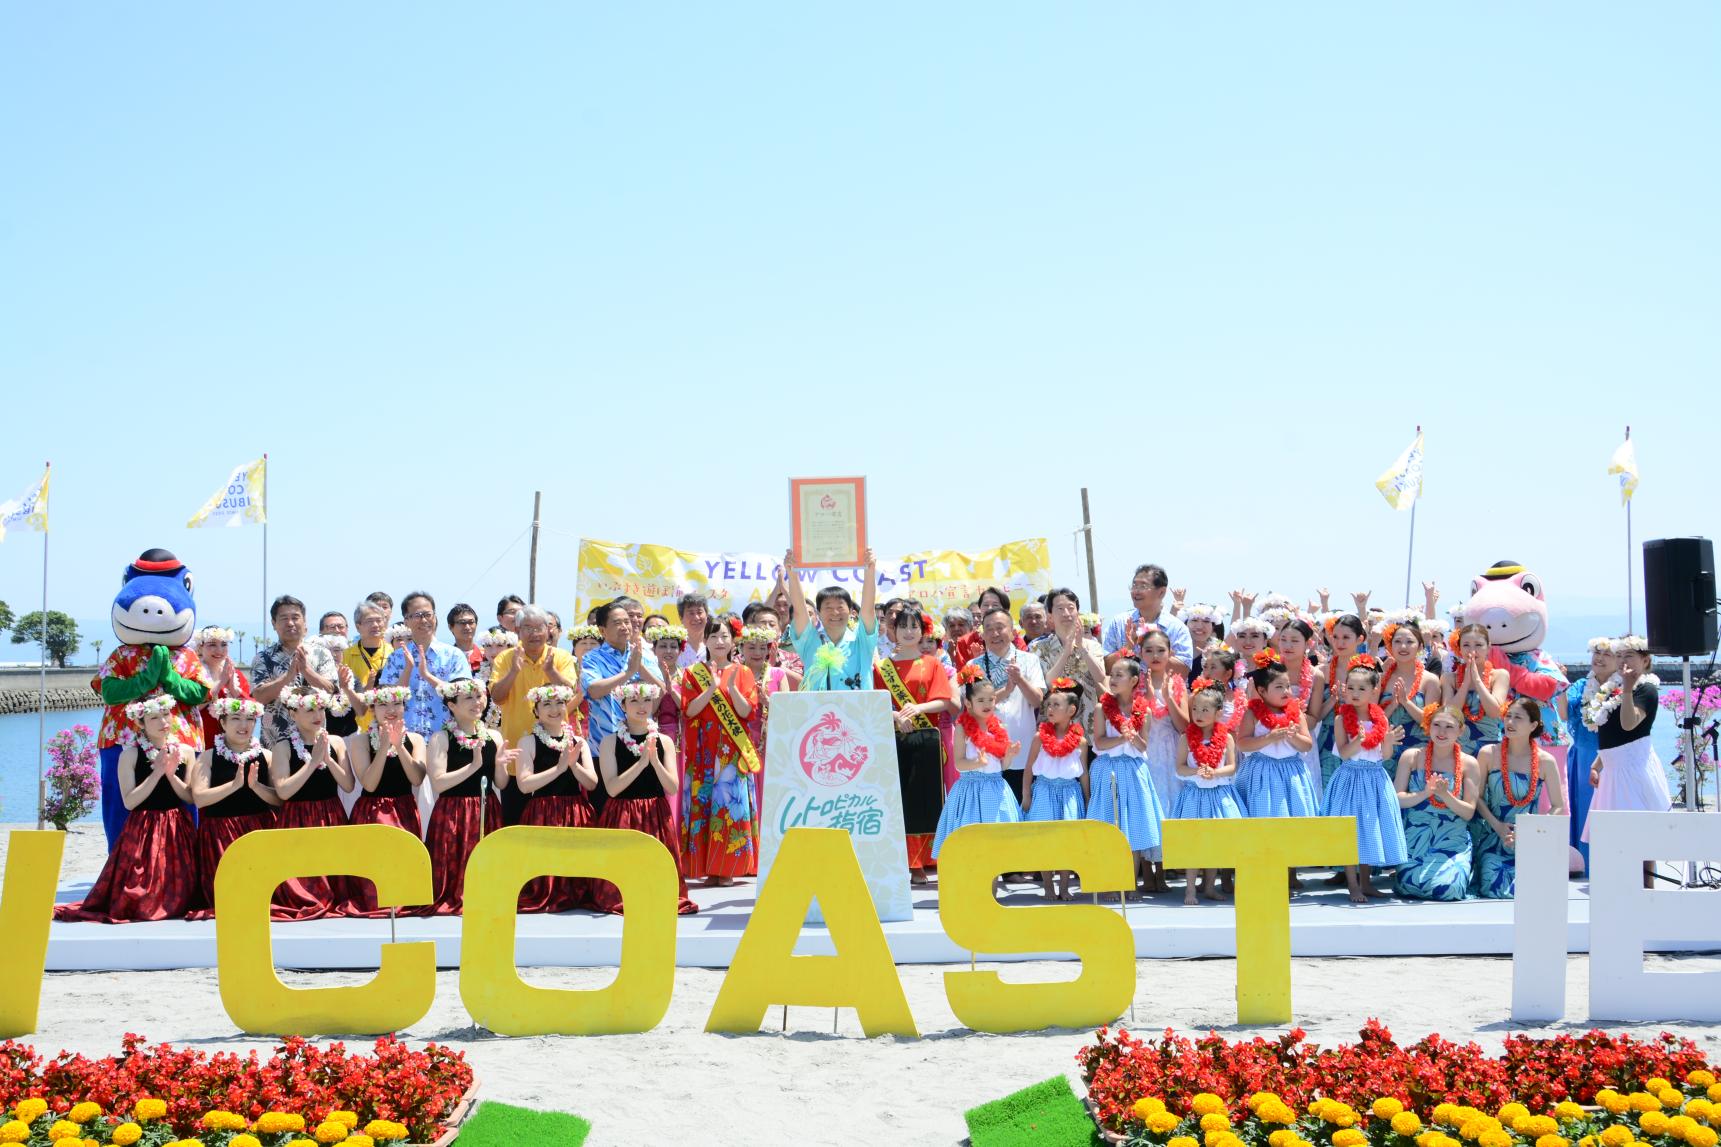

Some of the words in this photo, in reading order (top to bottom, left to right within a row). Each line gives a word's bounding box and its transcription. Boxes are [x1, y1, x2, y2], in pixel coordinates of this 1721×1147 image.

[779, 793, 878, 835] レトロピカル
[829, 807, 885, 836] 指宿
[214, 815, 1359, 1038] COAST
